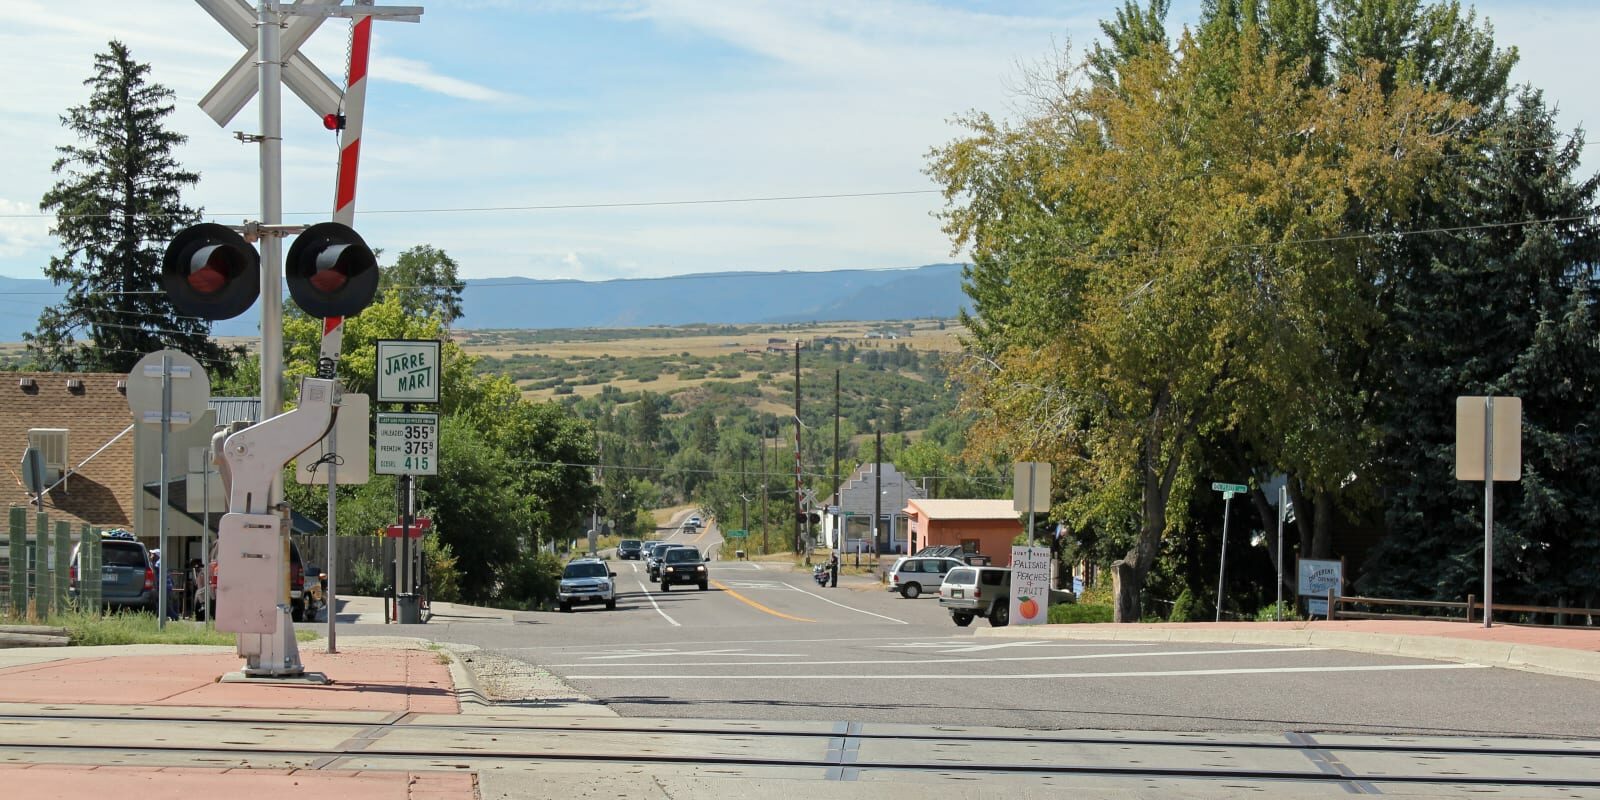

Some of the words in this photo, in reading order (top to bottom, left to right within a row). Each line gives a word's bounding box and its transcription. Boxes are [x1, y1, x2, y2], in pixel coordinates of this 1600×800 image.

[385, 352, 425, 375] JARRE
[398, 366, 431, 392] MART
[380, 429, 404, 437] UNLEADED
[404, 456, 429, 471] 415
[1013, 560, 1048, 570] PALISADE
[1016, 572, 1048, 582] PEACHES
